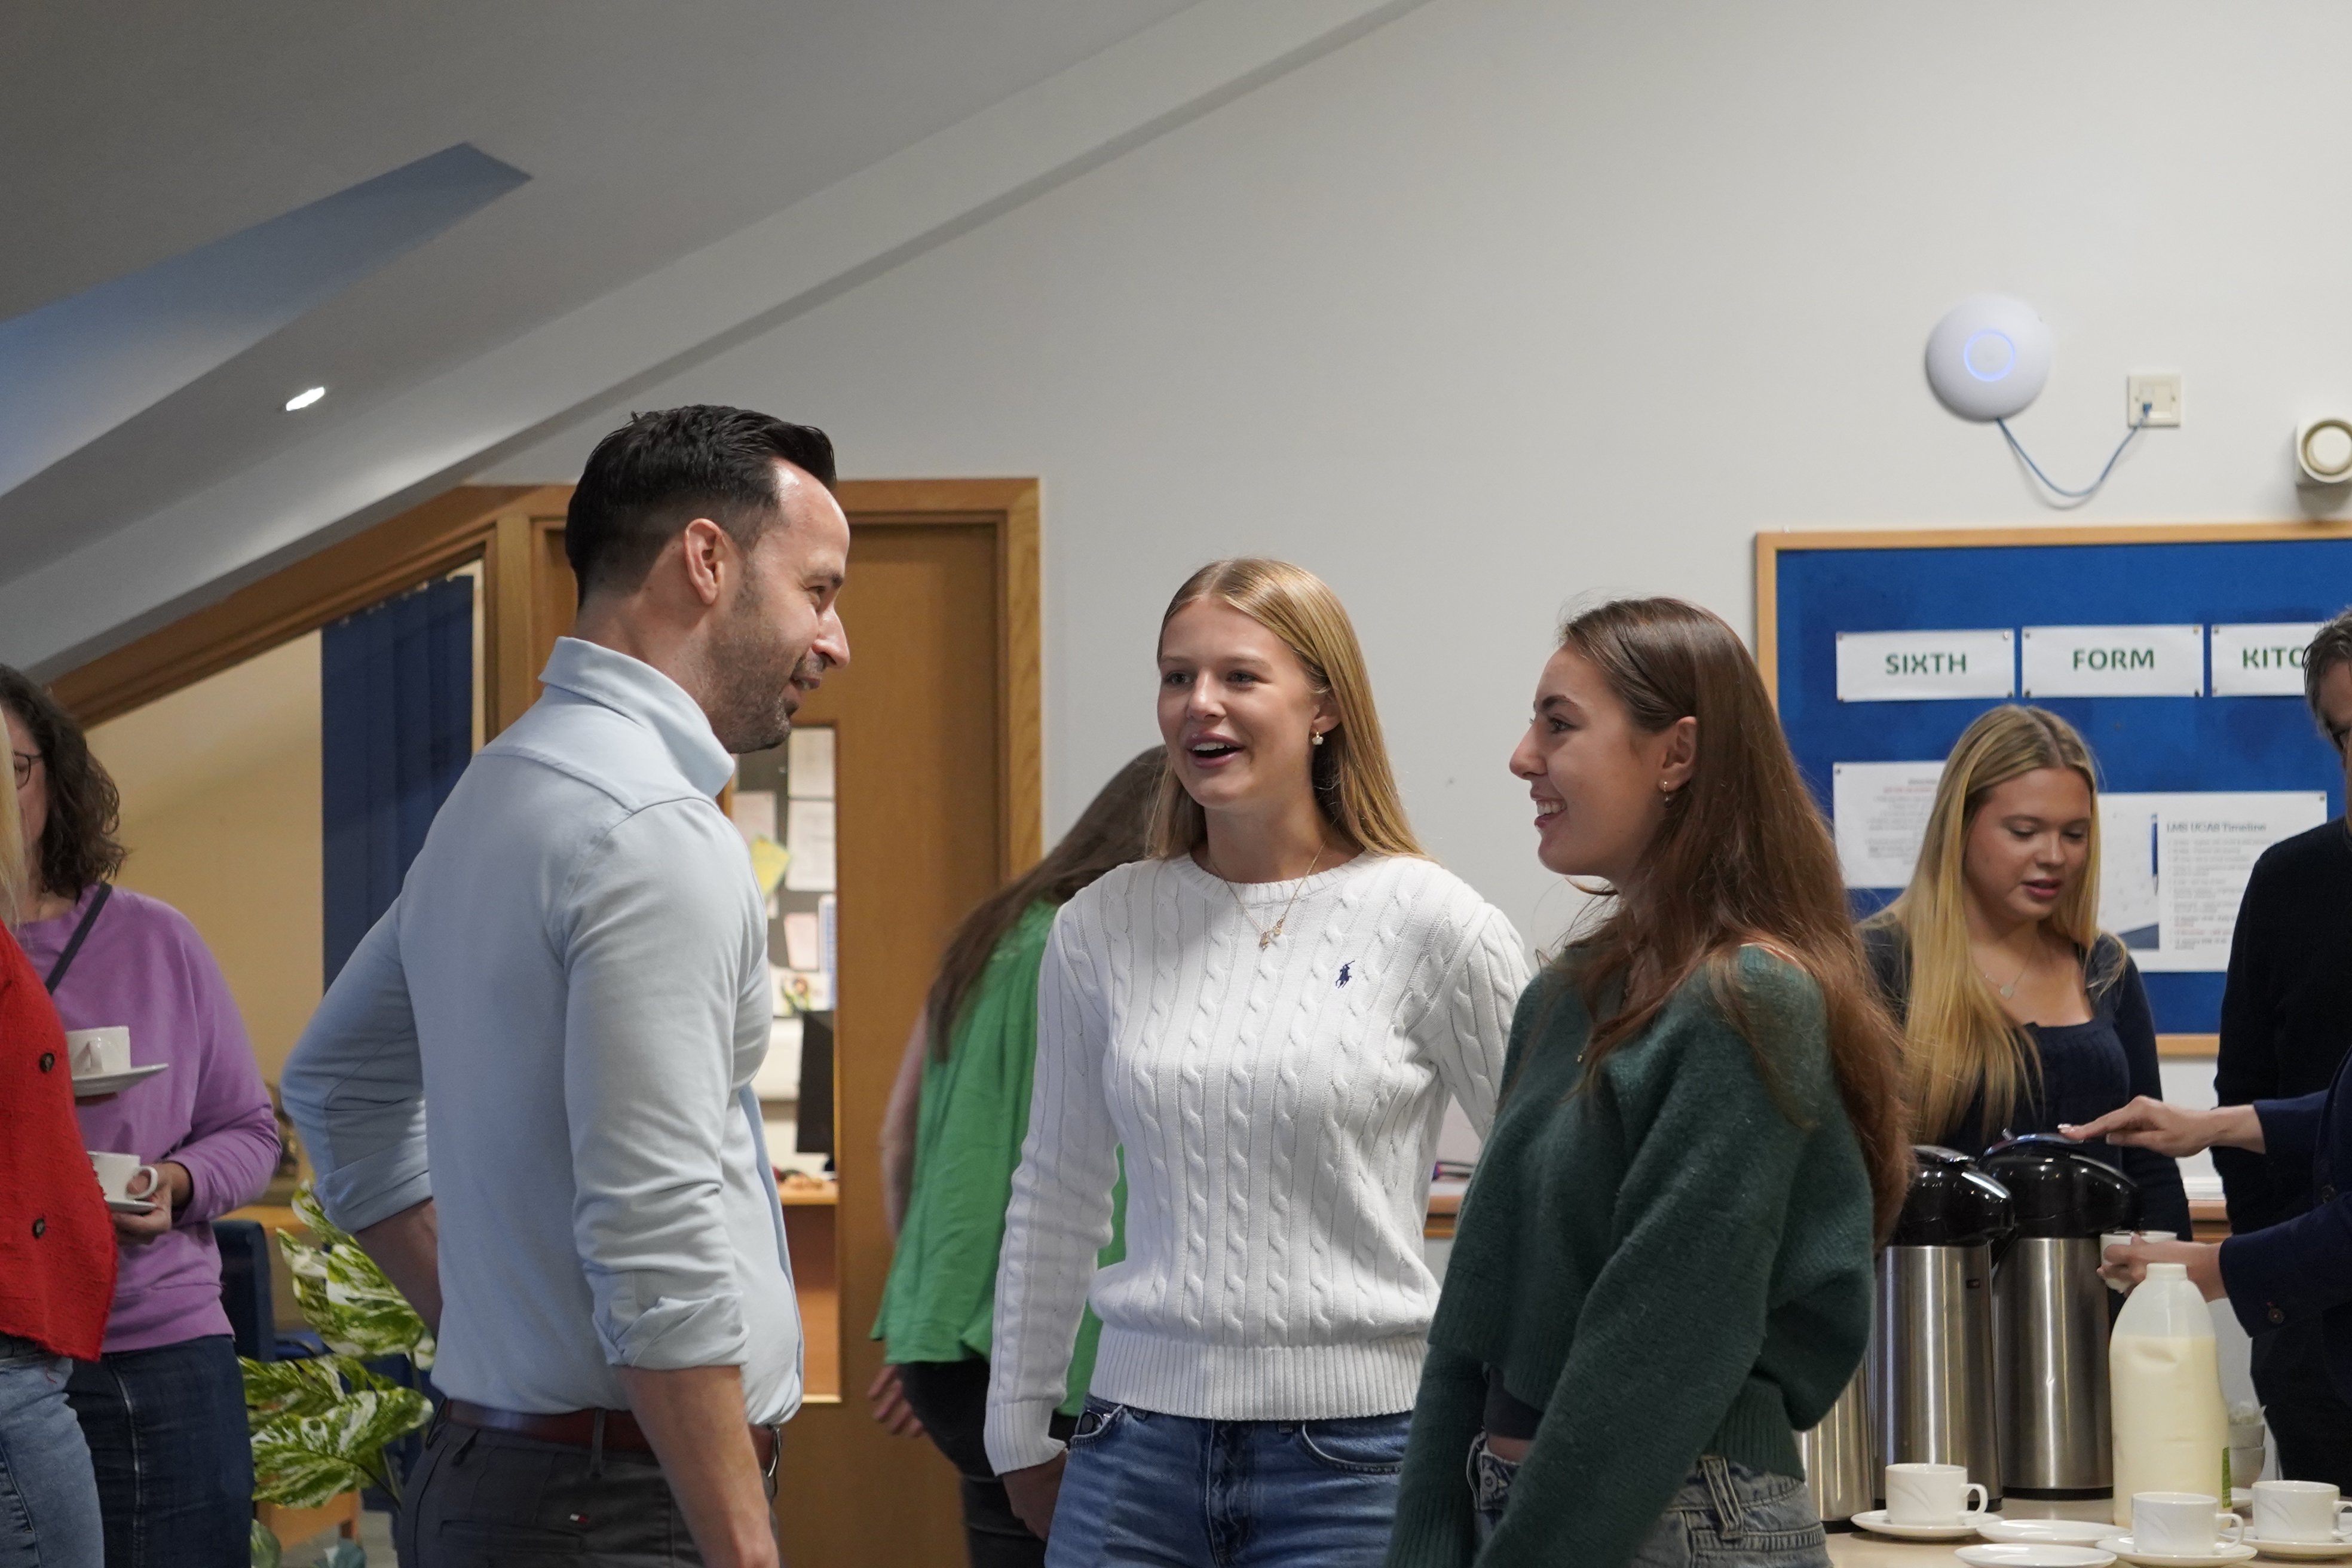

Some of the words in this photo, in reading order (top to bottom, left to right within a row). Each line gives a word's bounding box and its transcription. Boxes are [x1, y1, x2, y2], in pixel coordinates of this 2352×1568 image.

[1885, 652, 1967, 675] SIXTH
[2073, 648, 2154, 670] FORM
[2222, 822, 2267, 832] Timeline
